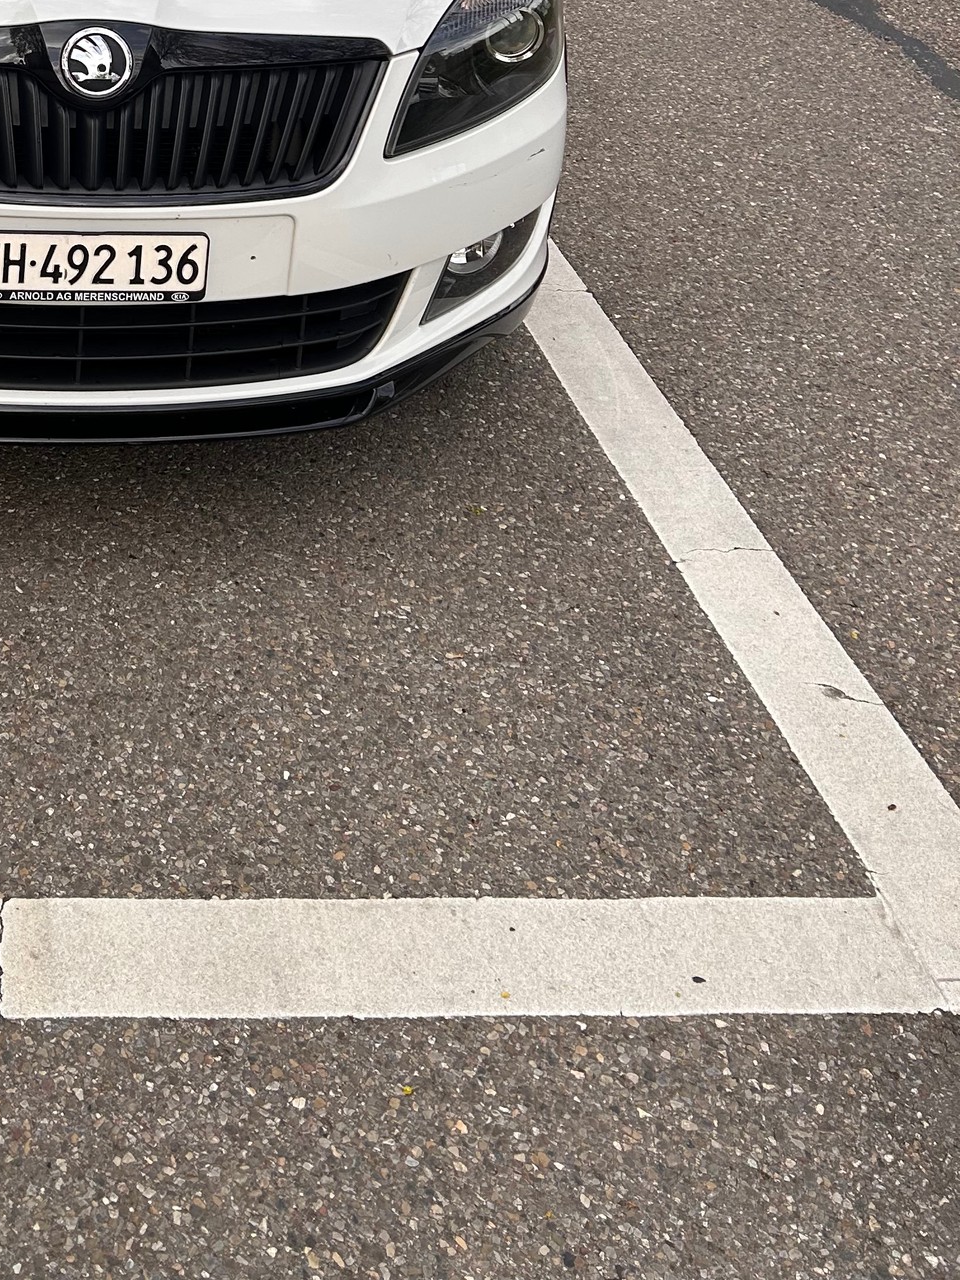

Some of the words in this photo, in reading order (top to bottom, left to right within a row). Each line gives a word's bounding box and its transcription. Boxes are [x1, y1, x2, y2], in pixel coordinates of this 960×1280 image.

[9, 291, 54, 301] ARNOLD
[56, 291, 72, 301] AG
[74, 292, 165, 301] MERENSCHWAND
[172, 293, 188, 301] KIA
